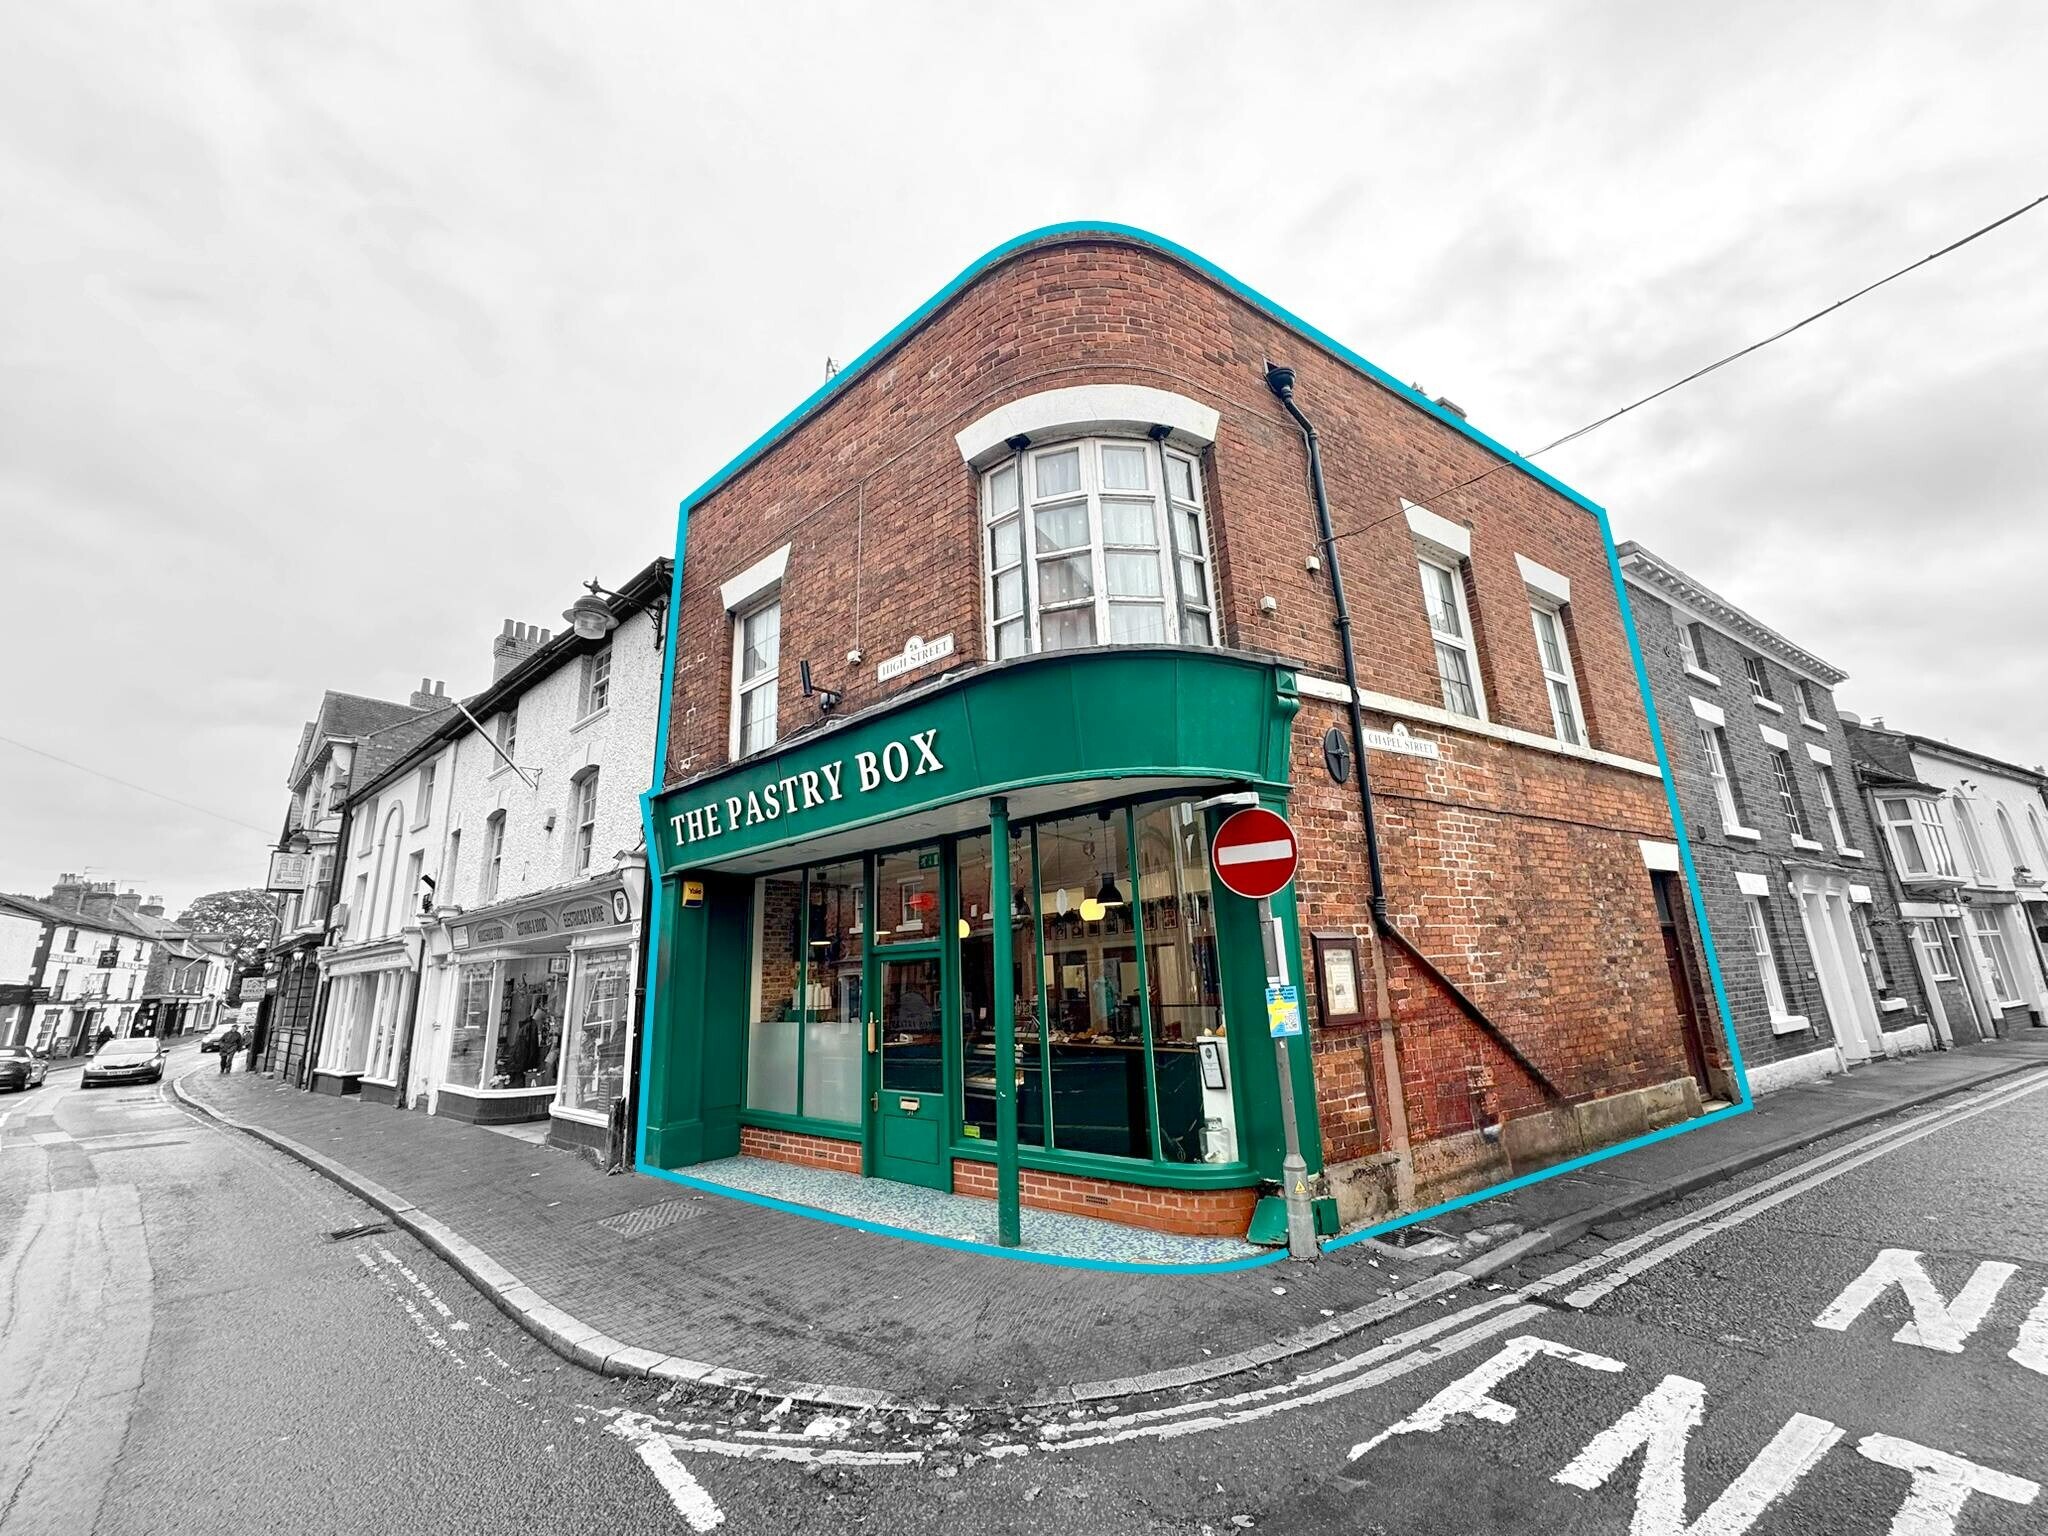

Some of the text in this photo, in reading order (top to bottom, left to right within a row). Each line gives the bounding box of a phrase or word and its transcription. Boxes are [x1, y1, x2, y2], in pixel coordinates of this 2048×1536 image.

[882, 641, 947, 676] HIGH STREET
[1368, 733, 1433, 754] CHAPEL STREET
[670, 728, 944, 847] THE PASTRY BOX
[688, 887, 702, 895] Yale
